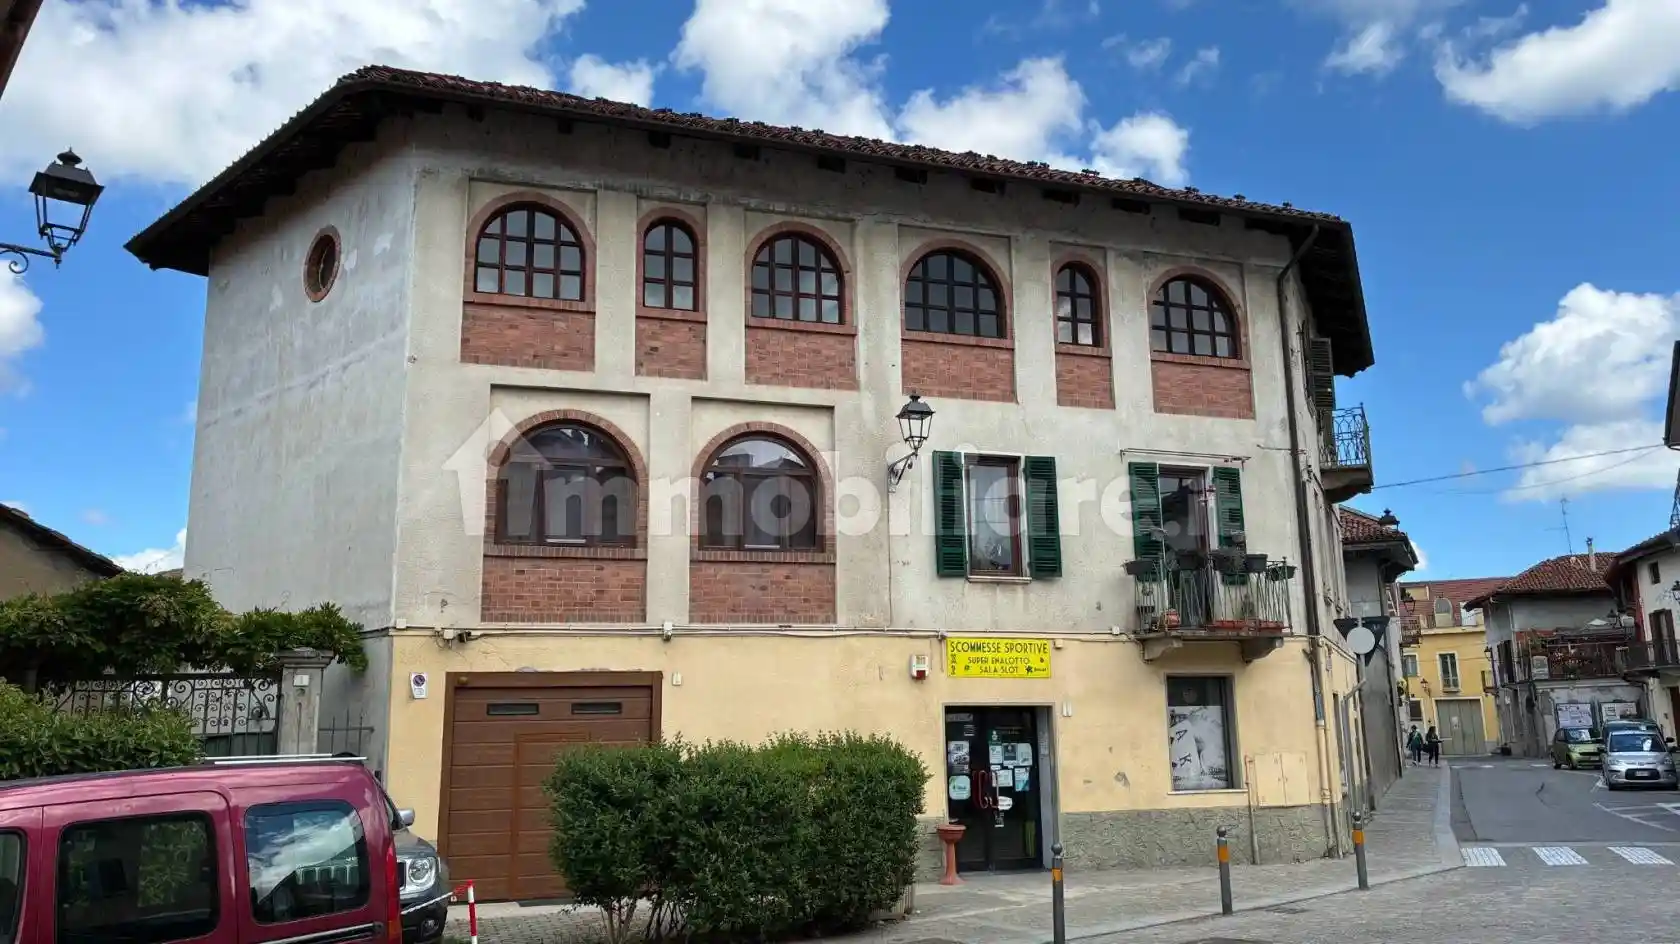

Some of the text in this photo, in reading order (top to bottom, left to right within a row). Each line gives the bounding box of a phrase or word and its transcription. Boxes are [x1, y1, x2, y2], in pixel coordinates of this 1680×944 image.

[950, 641, 1048, 654] SCOMMESSE SPORTIVE
[968, 656, 988, 665] SUPER
[979, 665, 998, 674] SALA
[1000, 665, 1019, 674] SLOT
